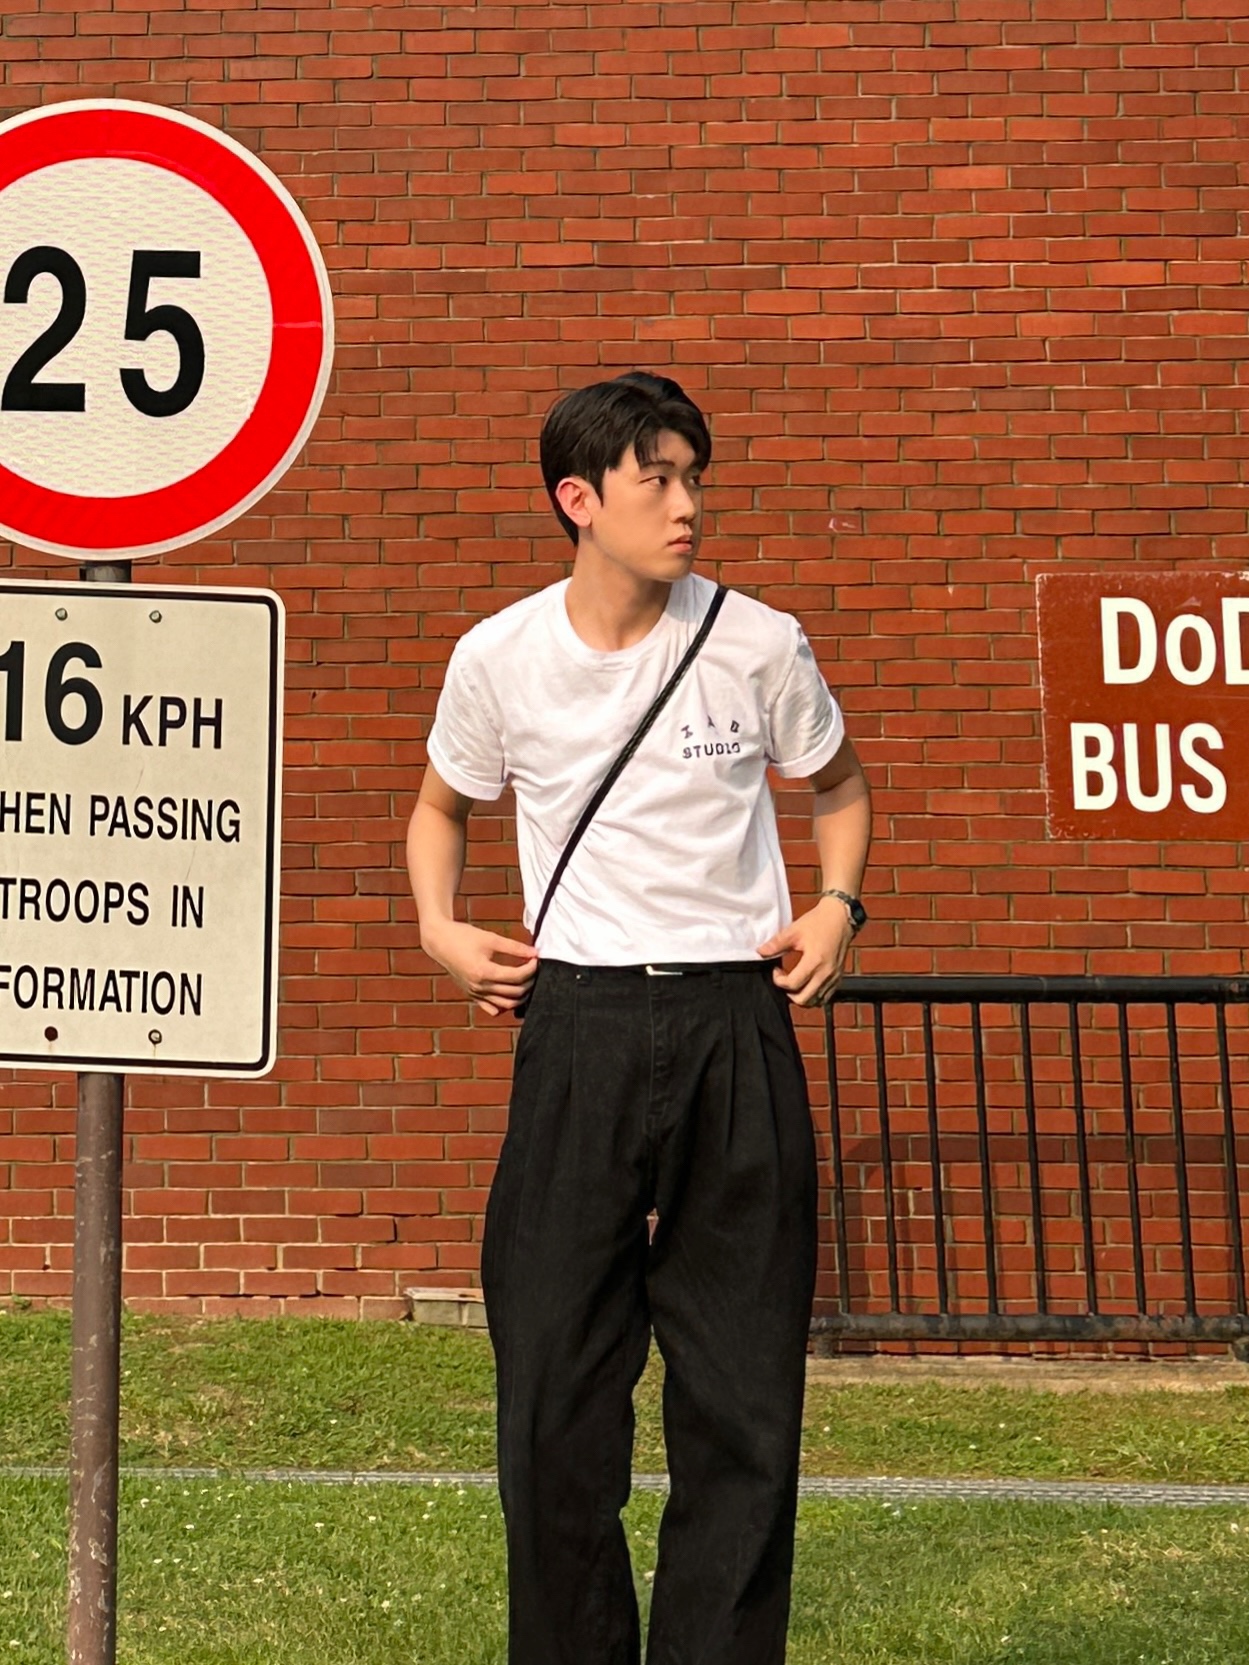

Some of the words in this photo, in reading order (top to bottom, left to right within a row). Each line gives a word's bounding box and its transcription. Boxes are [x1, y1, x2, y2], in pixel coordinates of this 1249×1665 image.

[1, 245, 206, 418] 25
[0, 640, 103, 746] 16
[122, 694, 223, 750] KPH
[1070, 722, 1227, 814] BUS
[89, 794, 241, 843] PASSING
[0, 877, 150, 926] TROOPS
[171, 884, 204, 929] IN
